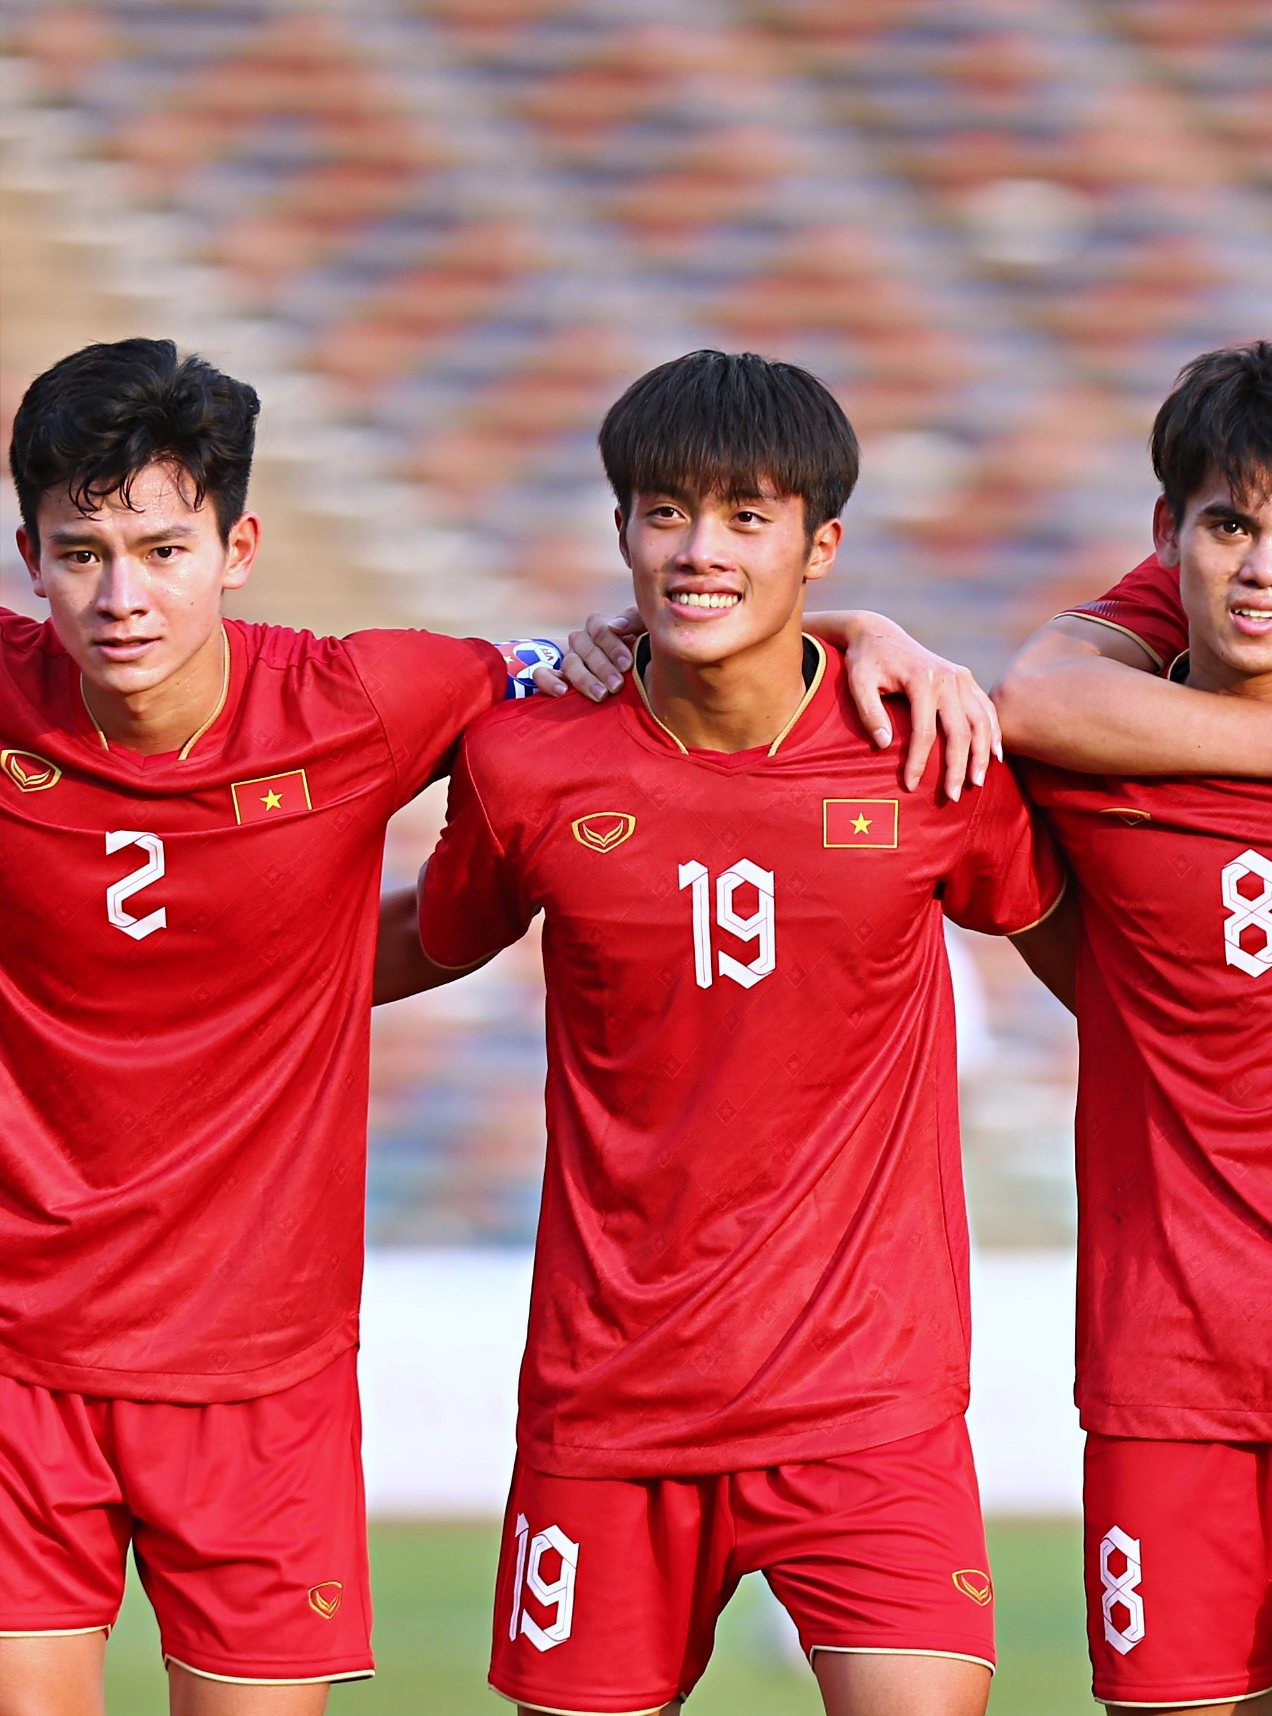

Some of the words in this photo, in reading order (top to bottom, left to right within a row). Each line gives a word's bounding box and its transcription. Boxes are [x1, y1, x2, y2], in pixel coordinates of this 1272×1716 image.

[105, 830, 167, 941] 2
[678, 858, 777, 990] 19
[508, 1513, 580, 1653] 19
[1099, 1525, 1146, 1656] 8
